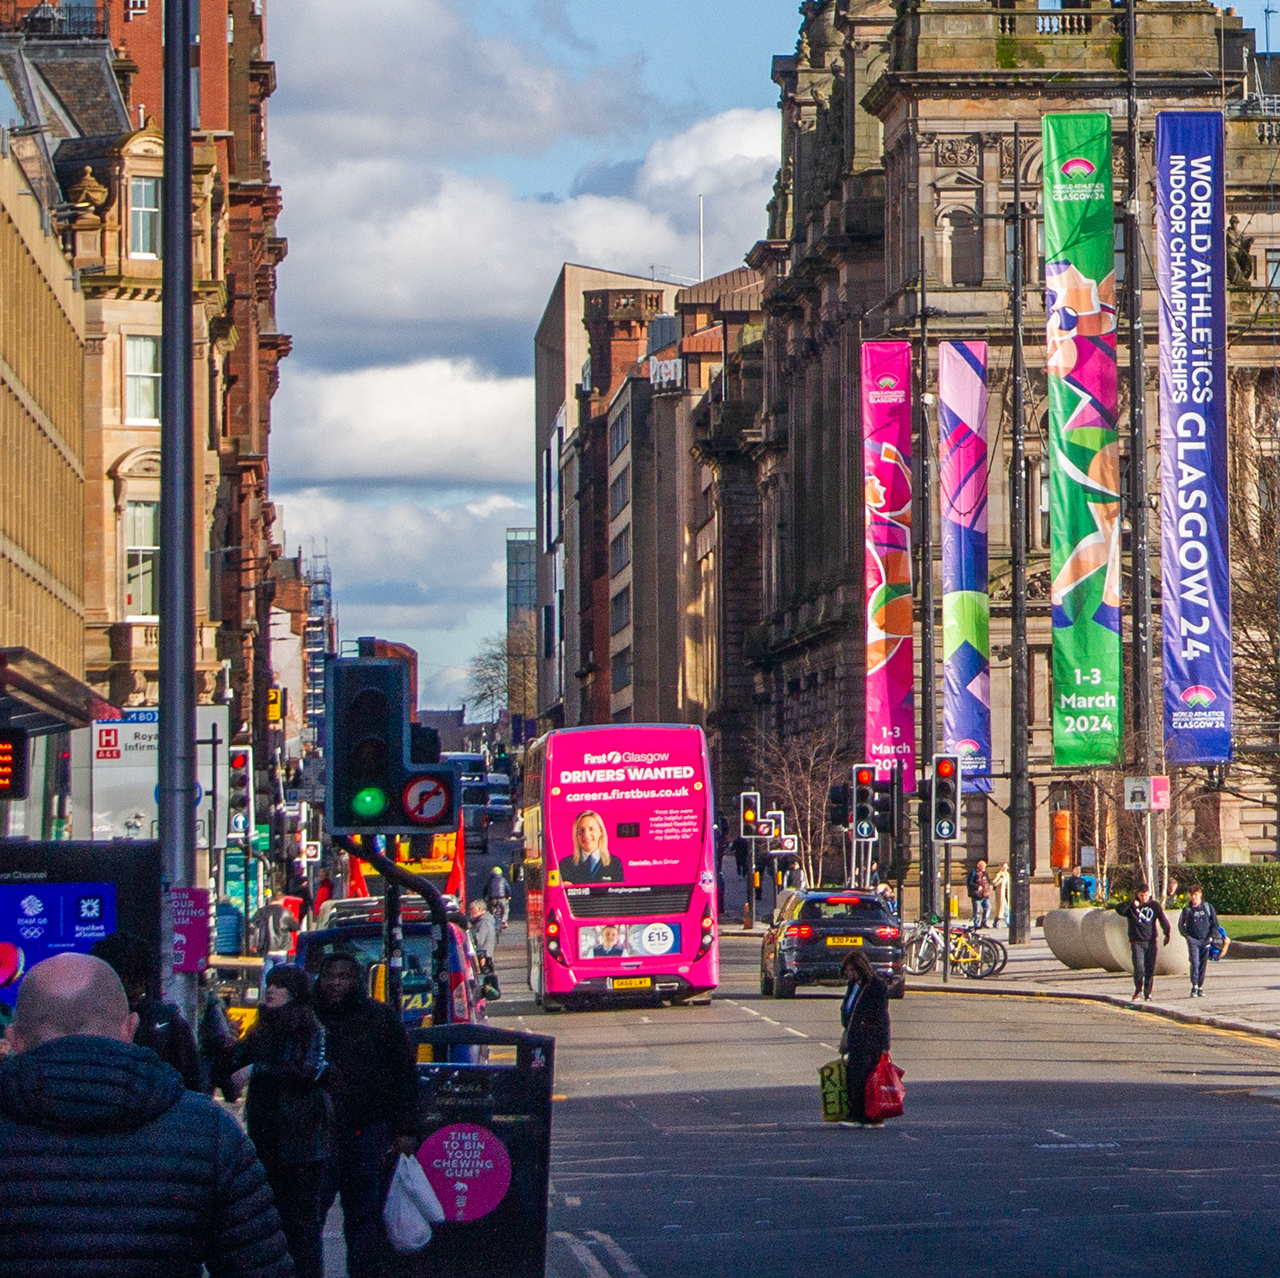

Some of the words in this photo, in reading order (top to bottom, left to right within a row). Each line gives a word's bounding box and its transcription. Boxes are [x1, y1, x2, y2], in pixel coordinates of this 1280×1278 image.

[1053, 193, 1093, 201] GLASGOW
[1094, 192, 1105, 200] 24
[1170, 154, 1186, 233] INDOOR
[1190, 155, 1212, 253] WORLD
[1170, 237, 1188, 404] CHAMPIONSHIPS
[1190, 259, 1213, 404] ATHLETICS
[1176, 411, 1209, 608] GLASGOW
[1180, 617, 1211, 661] 24
[1074, 668, 1102, 685] 1-3
[1060, 691, 1117, 709] March
[1064, 715, 1113, 733] 2024
[101, 730, 115, 746] H
[134, 731, 158, 742] Roya
[881, 726, 901, 738] 1-3
[125, 743, 158, 751] Infirm
[871, 742, 911, 754] March
[584, 753, 607, 765] First
[622, 751, 669, 764] Glasgow
[560, 770, 625, 784] DRIVERS
[627, 766, 694, 781] WANTED
[566, 786, 689, 802] careers.firstbus.co.uk
[171, 892, 189, 900] BIN
[172, 900, 194, 908] OUR
[648, 931, 669, 942] £15
[449, 1132, 479, 1141] TIME
[443, 1141, 460, 1150] TO
[464, 1141, 485, 1150] BIN
[446, 1150, 481, 1159] YOUR
[432, 1159, 494, 1169] CHEWING
[445, 1169, 481, 1178] GUM?
